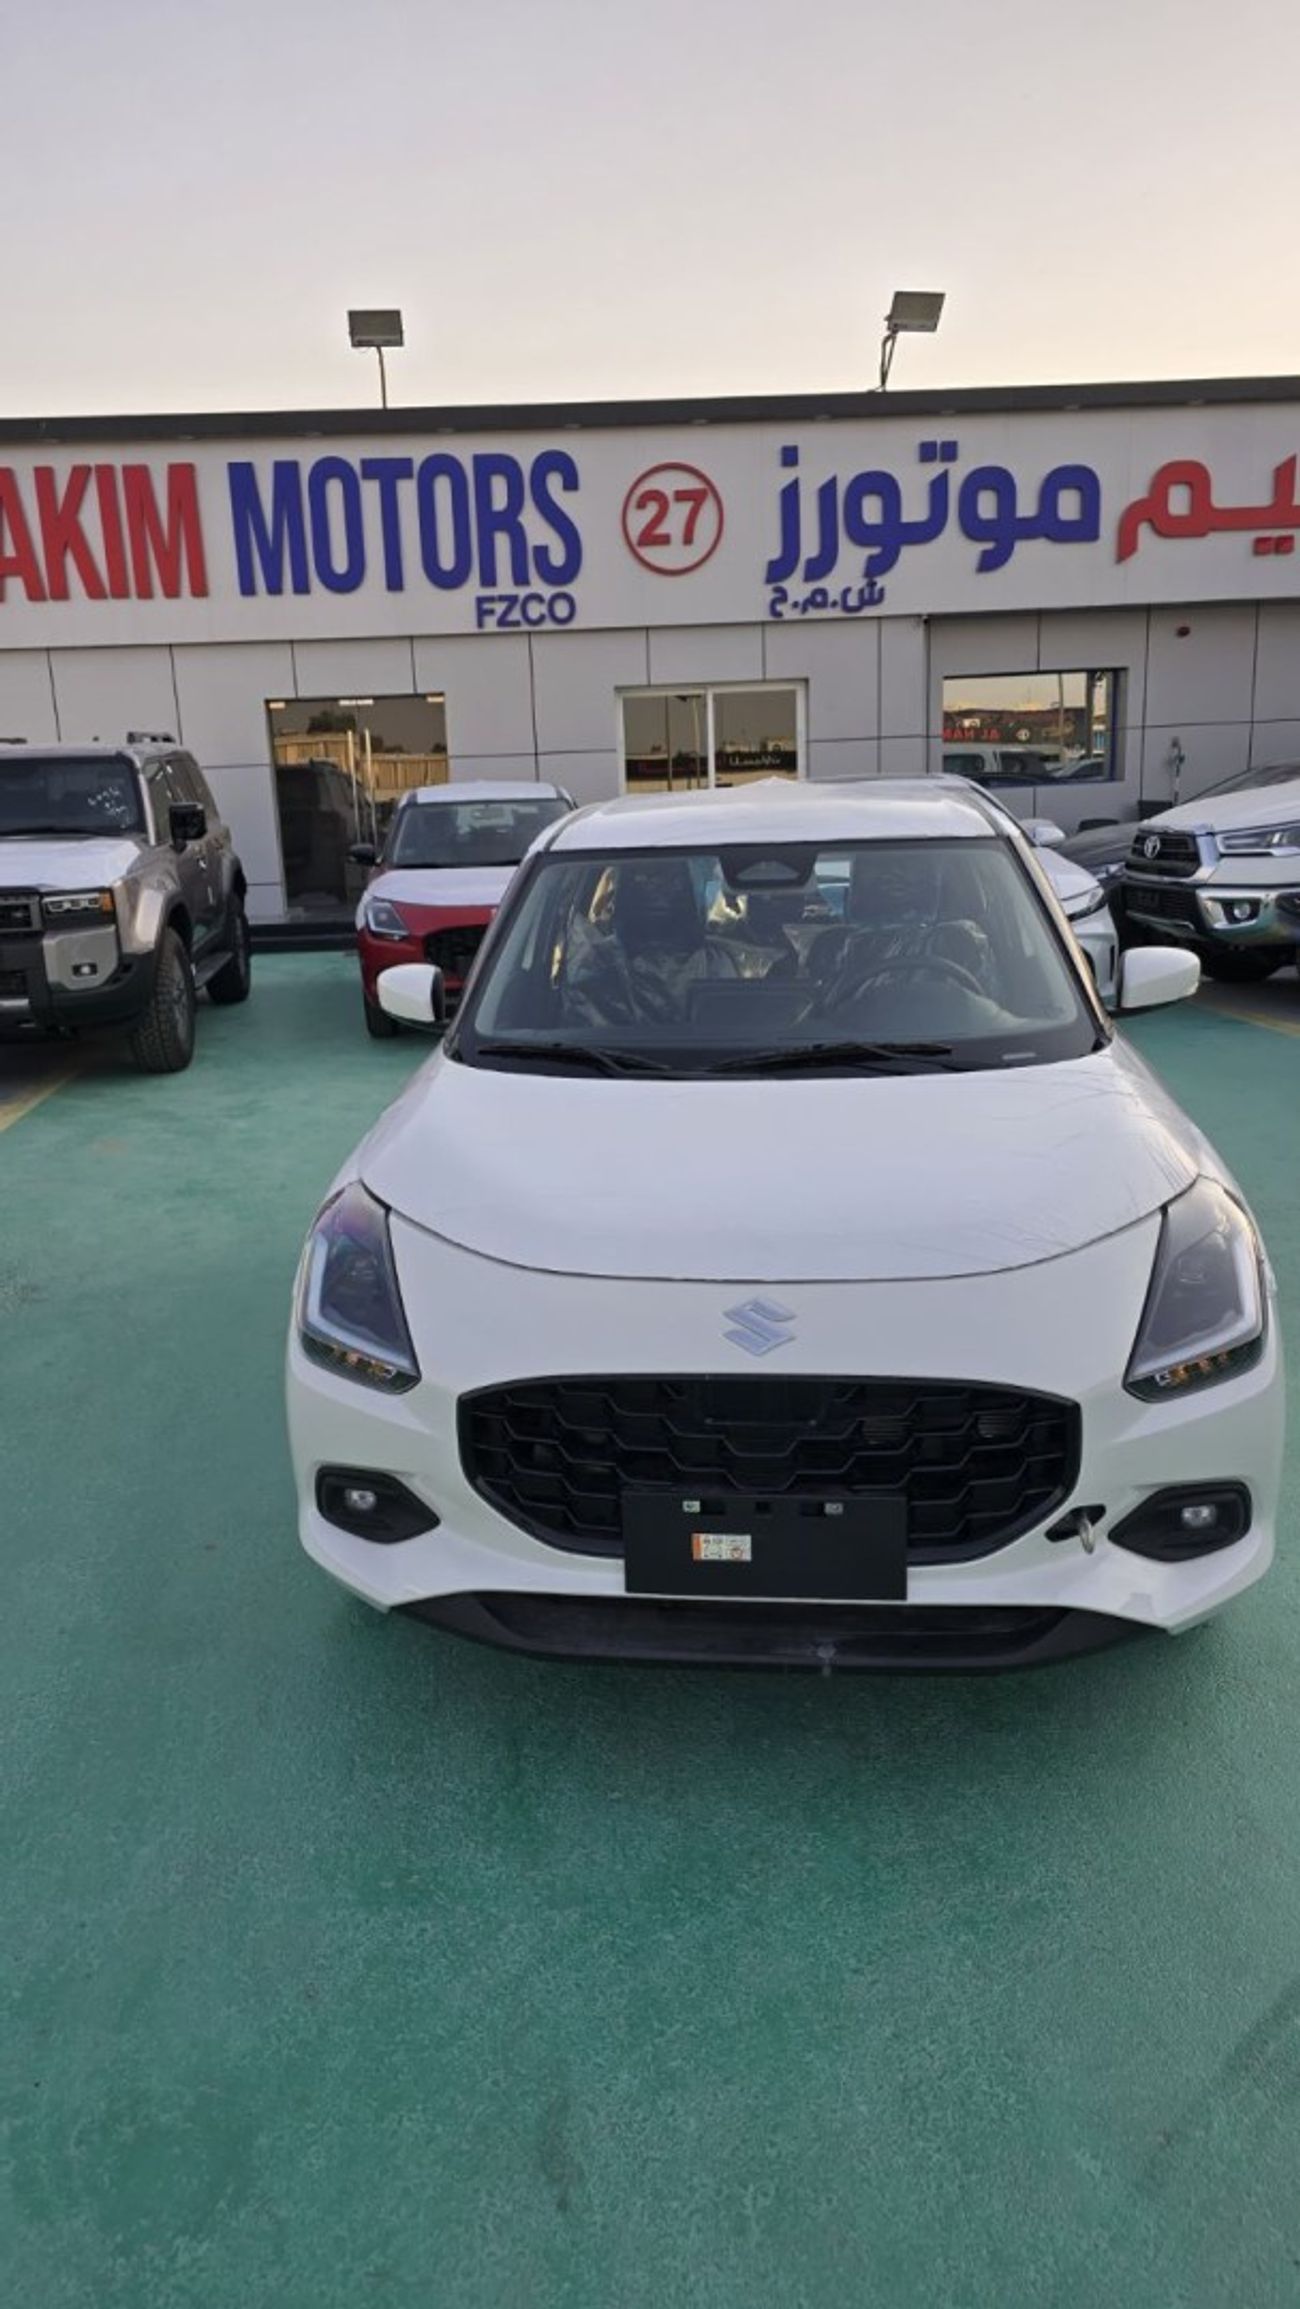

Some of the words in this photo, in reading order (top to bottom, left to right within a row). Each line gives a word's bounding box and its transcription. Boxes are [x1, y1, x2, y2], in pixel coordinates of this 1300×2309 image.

[227, 450, 583, 597] MOTORS
[635, 487, 709, 547] 27
[766, 440, 1101, 585] موتورز
[475, 591, 576, 629] FZCO
